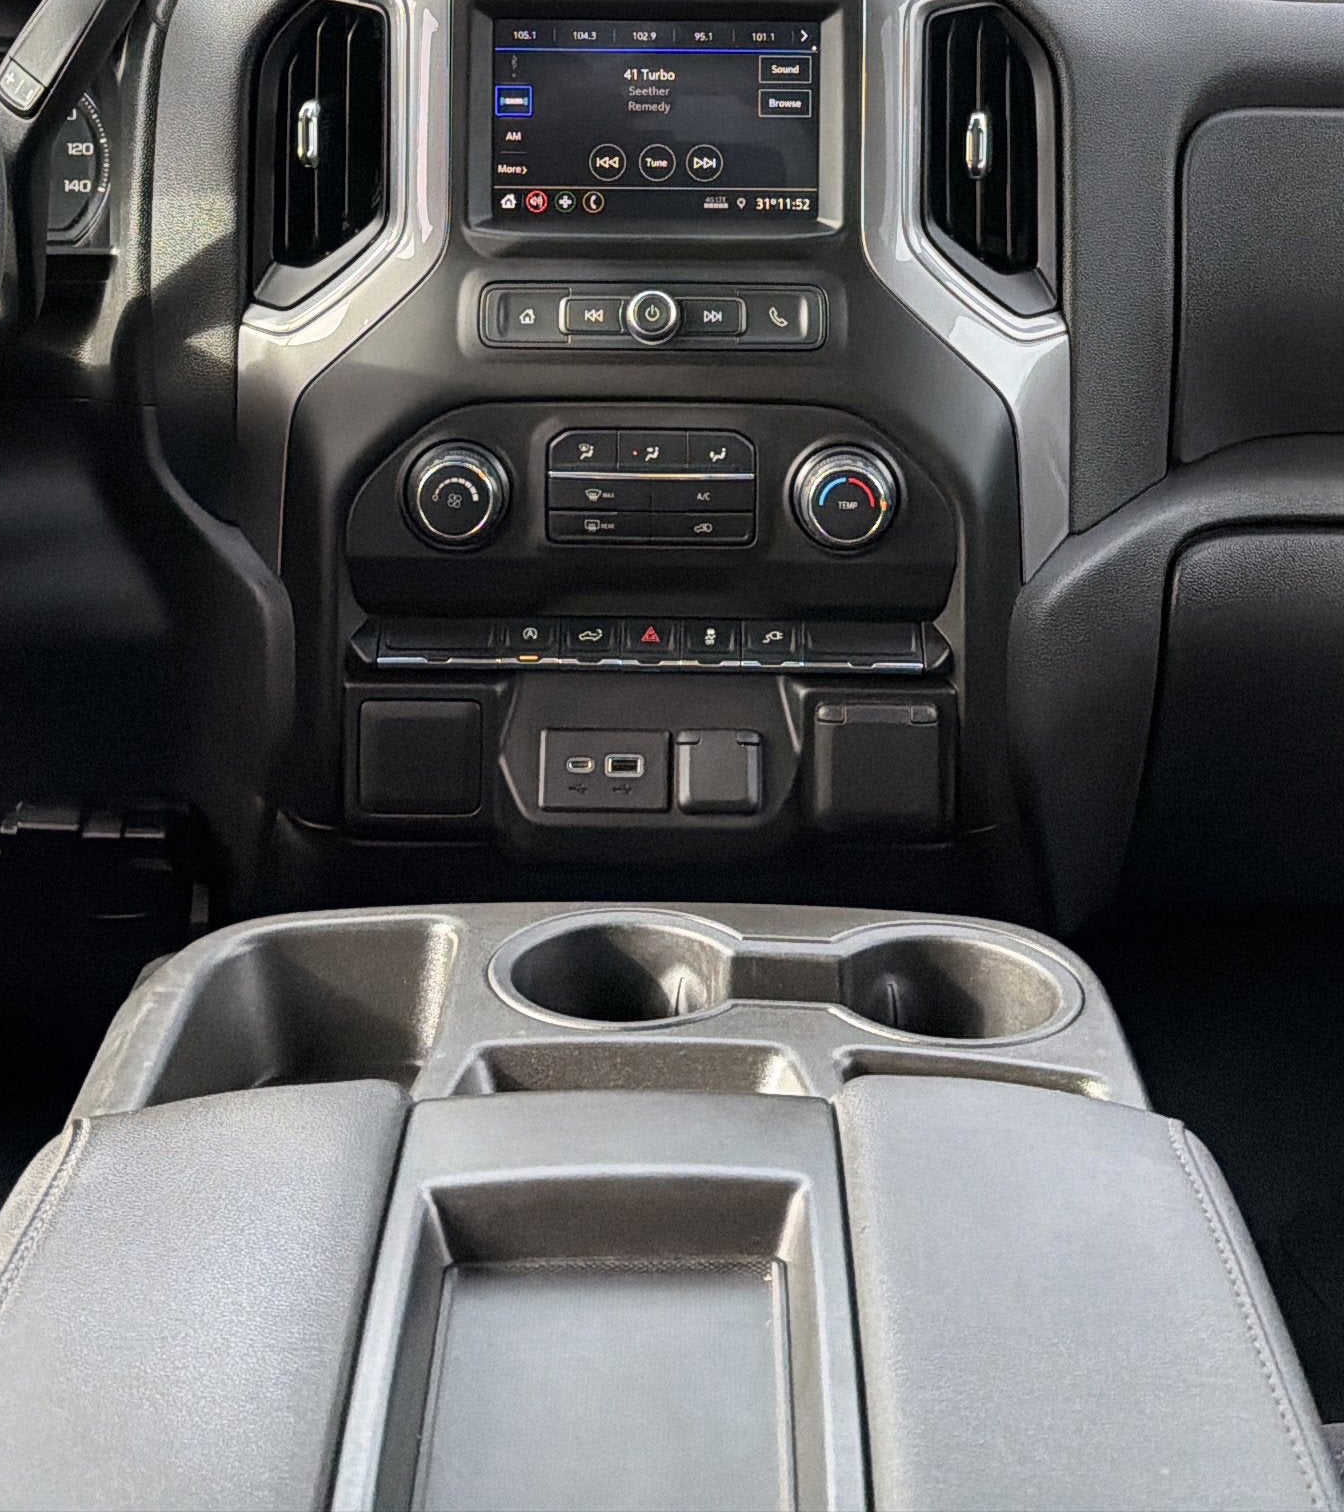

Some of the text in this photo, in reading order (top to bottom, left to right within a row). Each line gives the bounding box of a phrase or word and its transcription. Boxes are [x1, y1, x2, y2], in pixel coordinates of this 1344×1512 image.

[513, 31, 776, 42] 105.1 104.3 102.9 95.1 101.1
[623, 69, 676, 81] 41 Turbo
[771, 64, 800, 75] Sound
[628, 86, 670, 97] Seether
[628, 101, 671, 114] Remedy
[769, 98, 802, 109] Browse
[505, 132, 522, 141] AM
[67, 142, 94, 156] 120
[645, 158, 669, 168] Tune
[63, 179, 92, 193] 140
[777, 198, 811, 210] 11:52
[696, 492, 712, 501] A/C
[837, 500, 859, 510] TEMP
